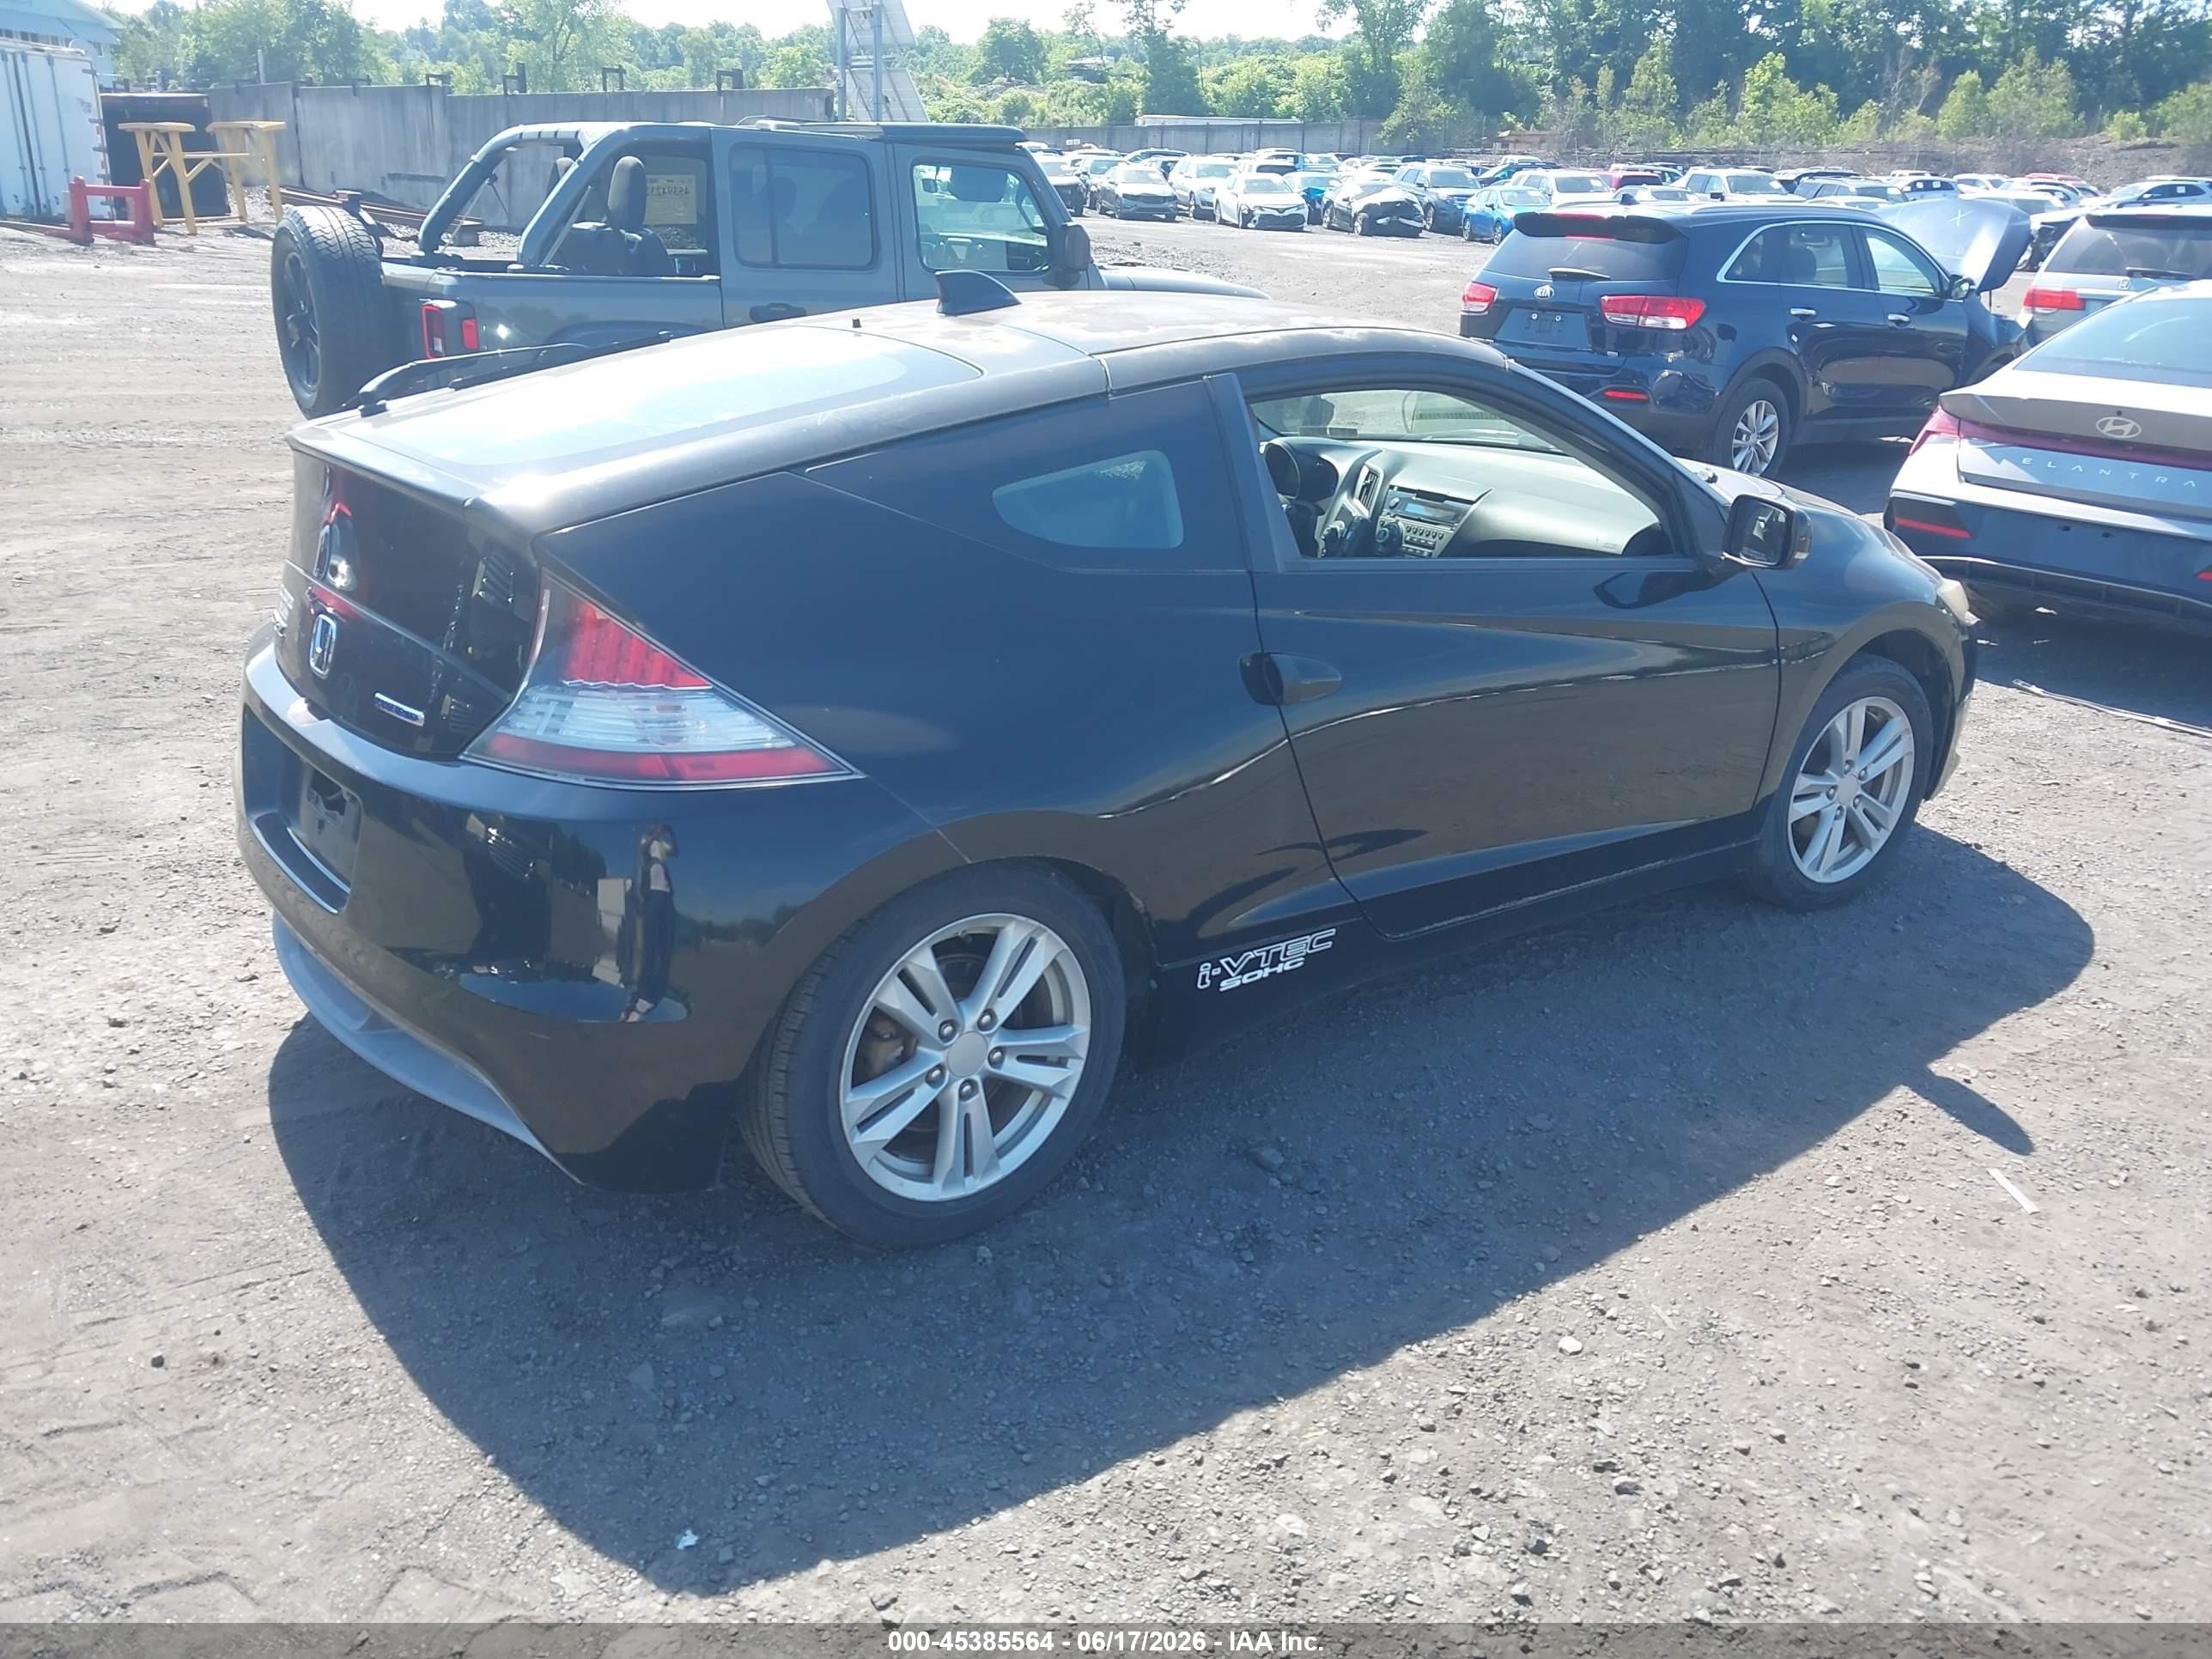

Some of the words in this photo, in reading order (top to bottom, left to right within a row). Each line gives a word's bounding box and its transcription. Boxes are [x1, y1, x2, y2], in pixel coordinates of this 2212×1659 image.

[2021, 457, 2197, 488] ELANTRA
[1196, 927, 1337, 989] i-VTEC
[1218, 957, 1305, 992] SOHC
